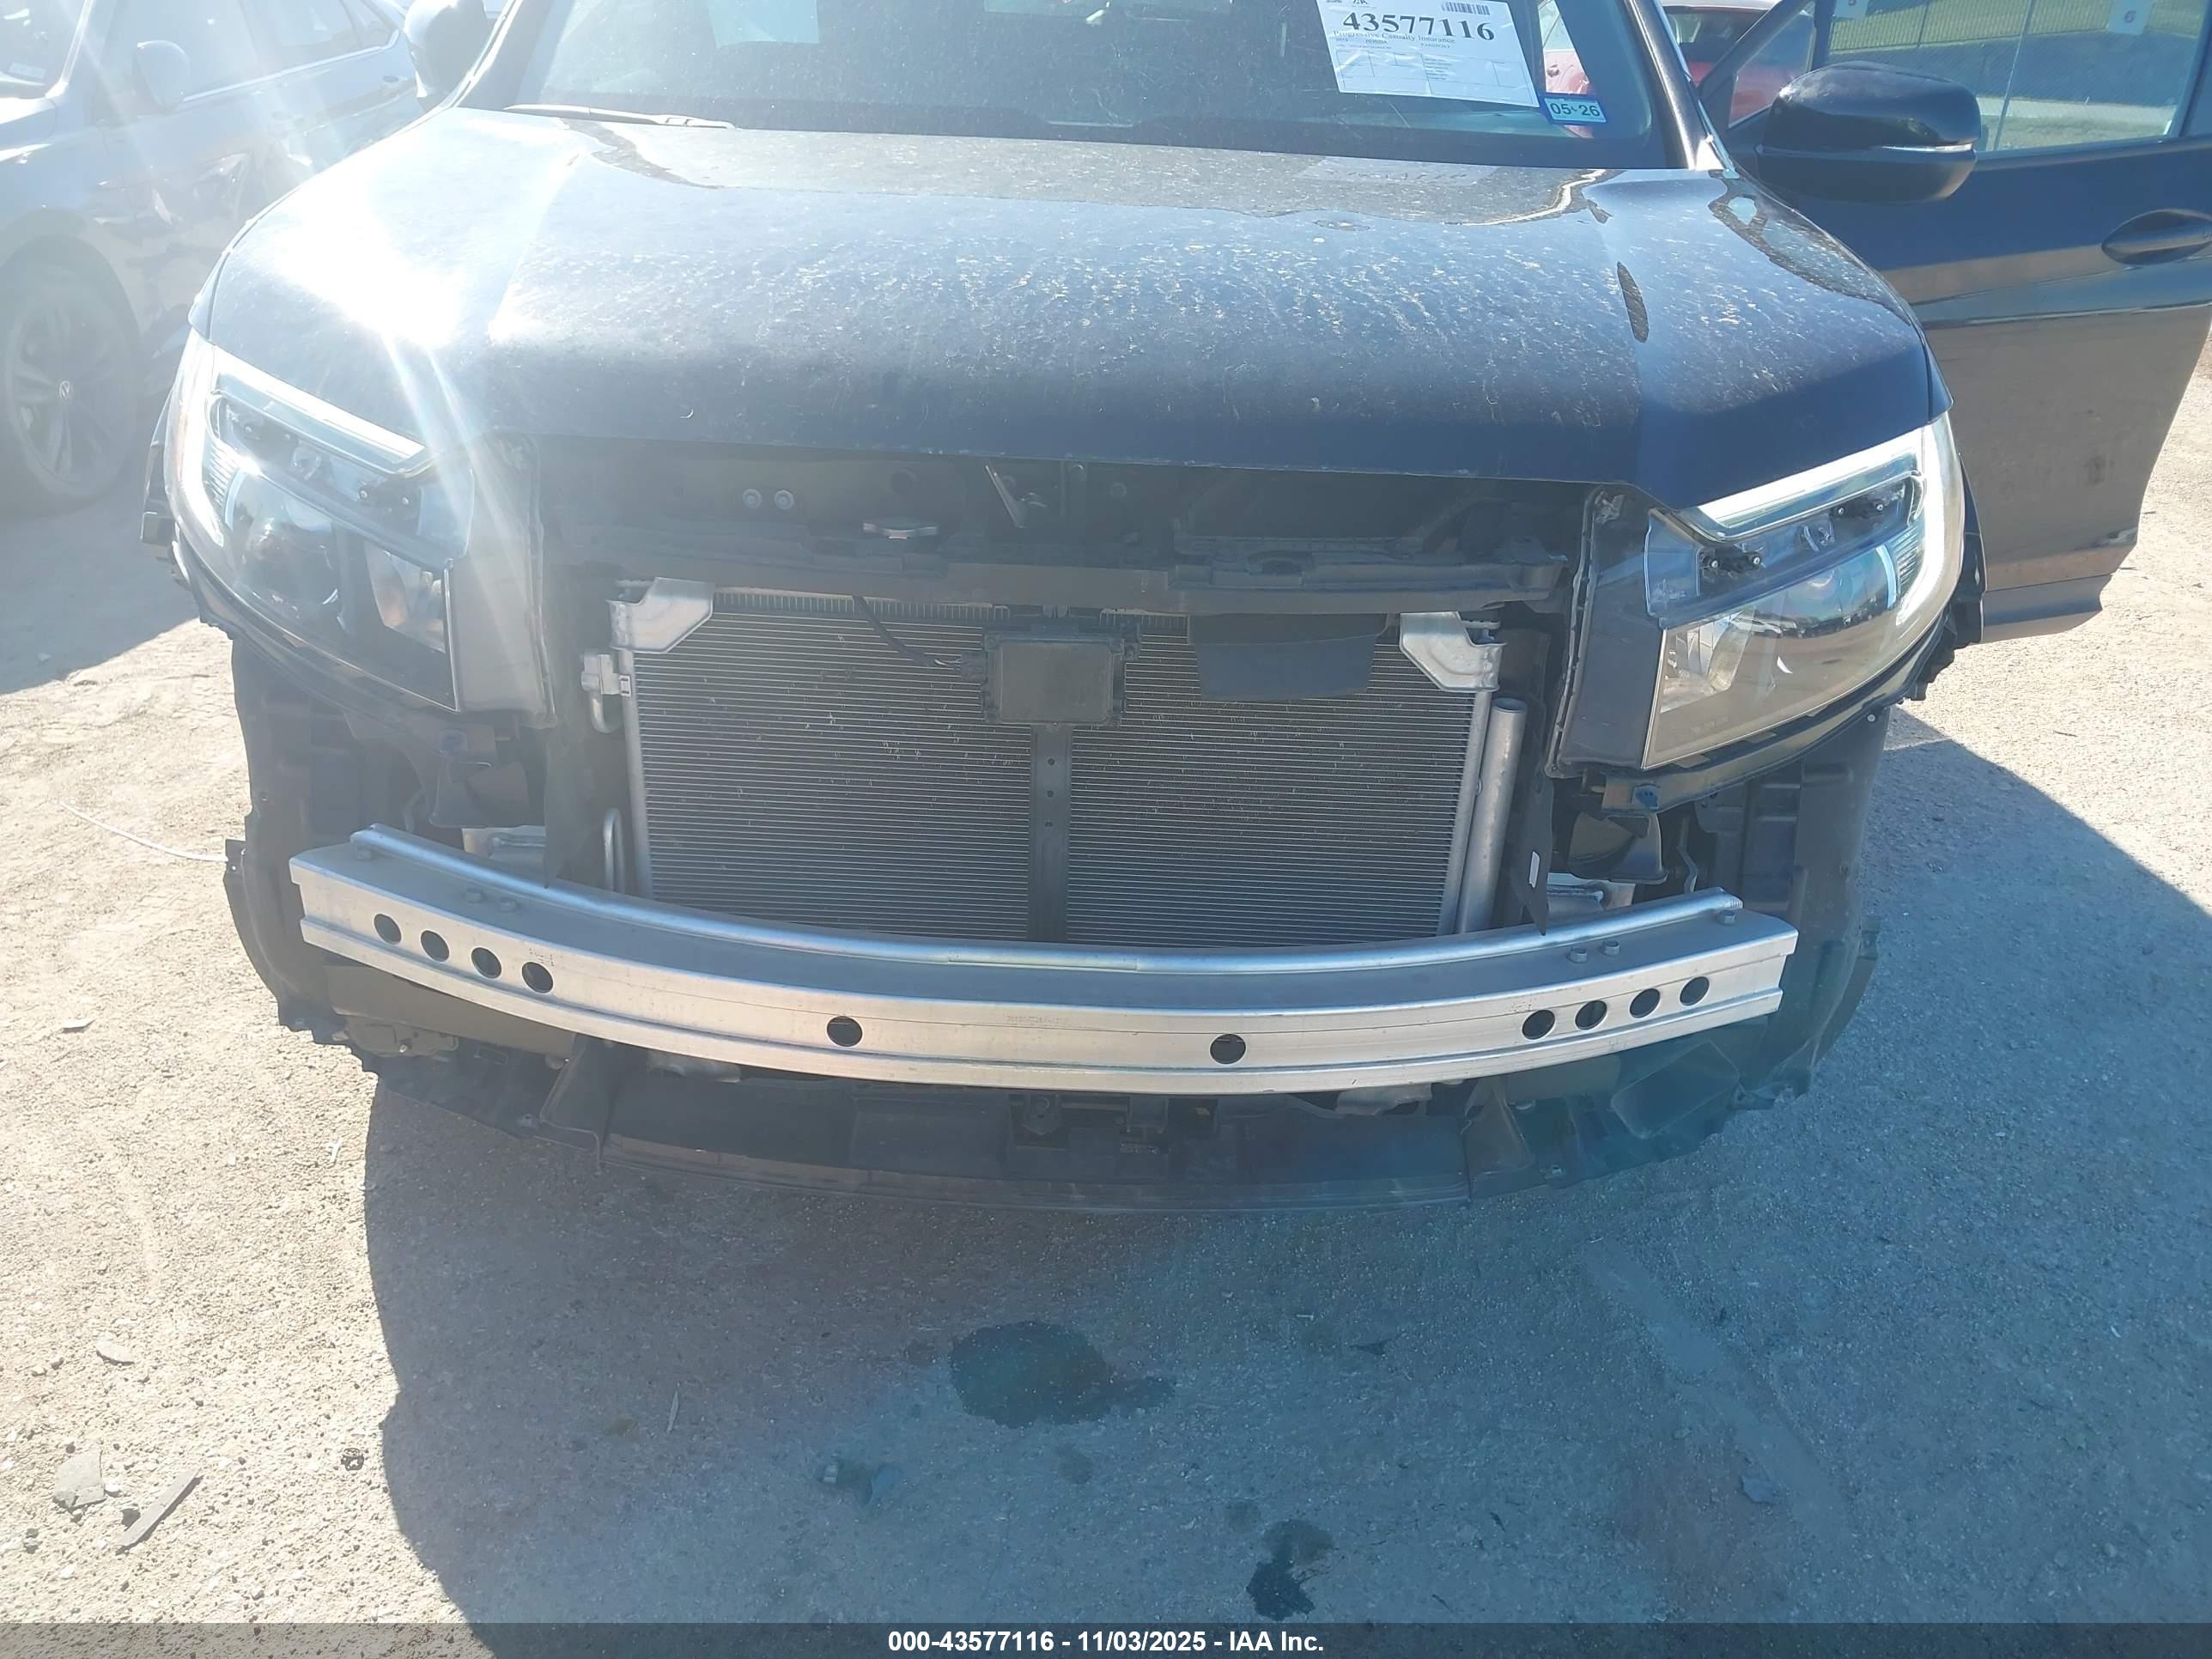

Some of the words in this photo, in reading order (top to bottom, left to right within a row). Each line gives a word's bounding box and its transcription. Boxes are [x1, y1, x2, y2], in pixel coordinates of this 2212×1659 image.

[1343, 12, 1495, 41] 43577116
[1382, 33, 1416, 41] Casualty
[1418, 35, 1456, 44] Insurance
[1550, 102, 1571, 115] 05
[1579, 104, 1600, 117] 26
